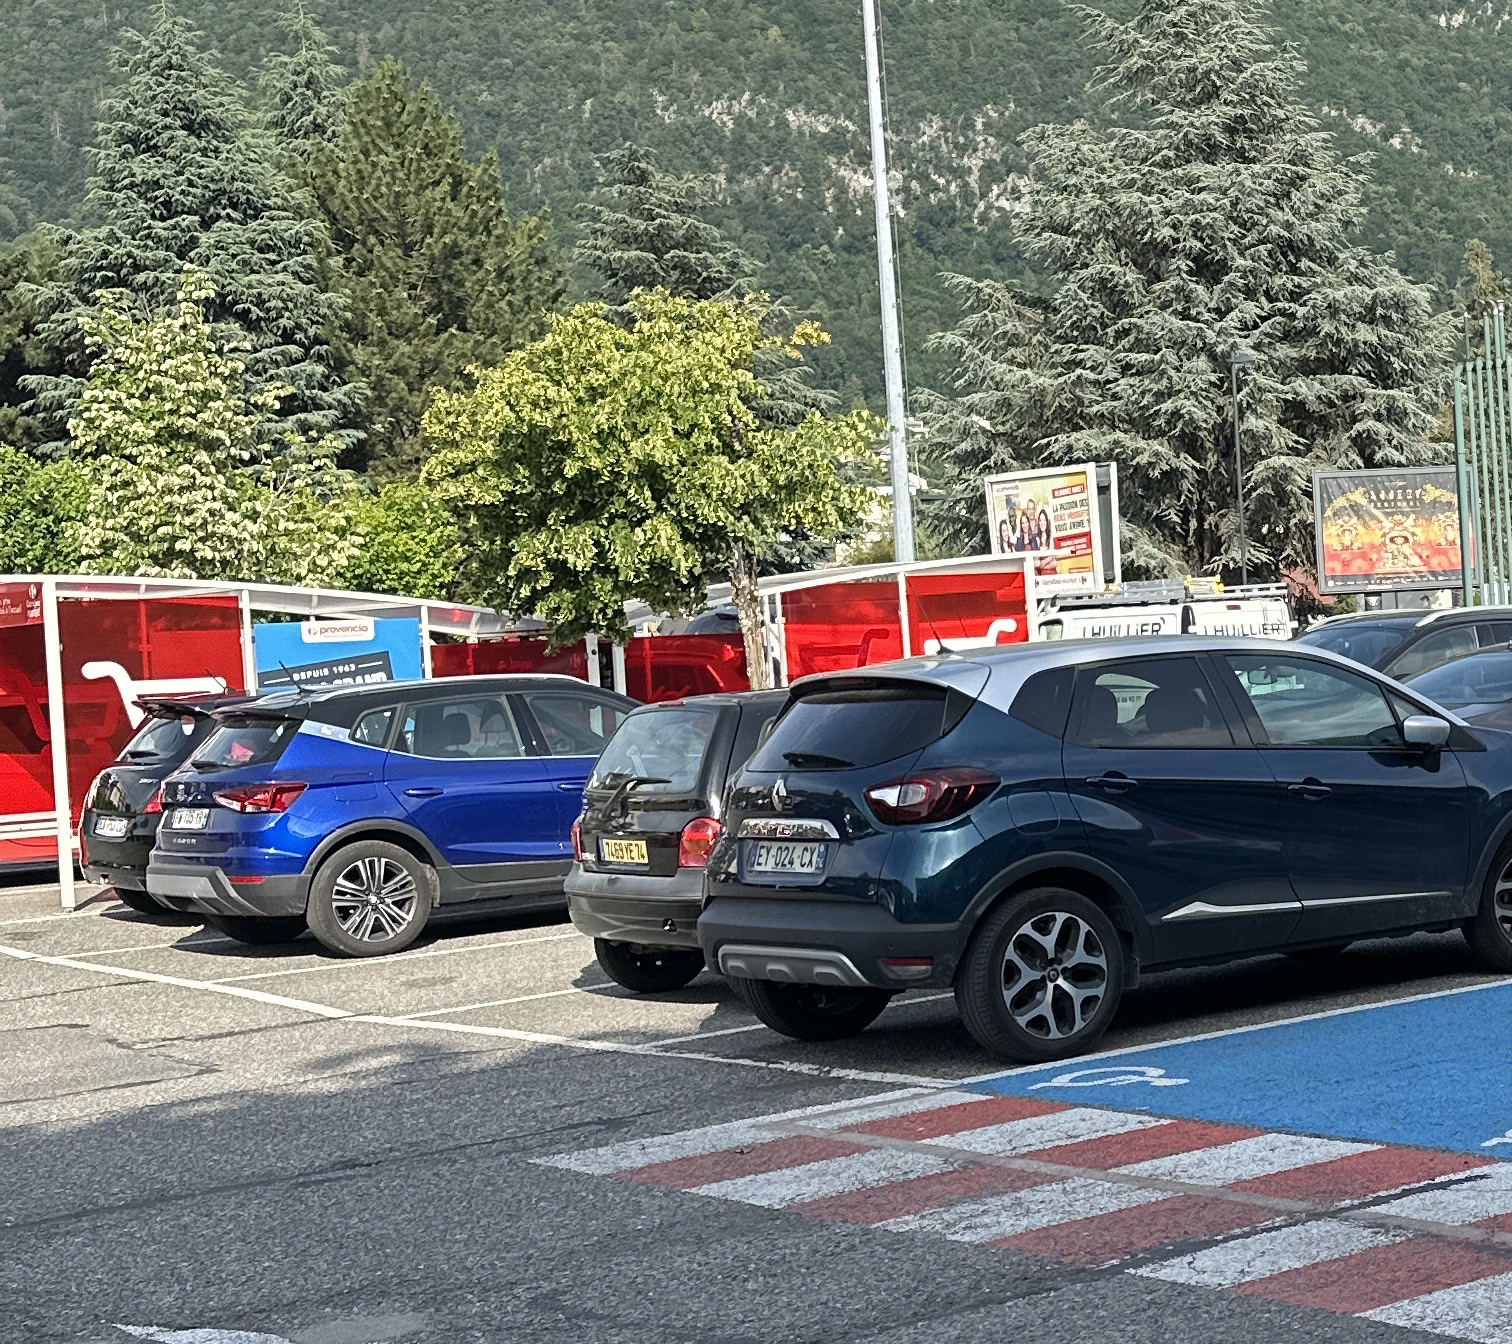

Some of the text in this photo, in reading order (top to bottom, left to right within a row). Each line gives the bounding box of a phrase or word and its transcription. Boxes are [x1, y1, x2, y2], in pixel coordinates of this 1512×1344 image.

[319, 623, 368, 635] provencia
[292, 663, 356, 681] DEPUIS 1963
[756, 845, 817, 868] EY-024-CX
